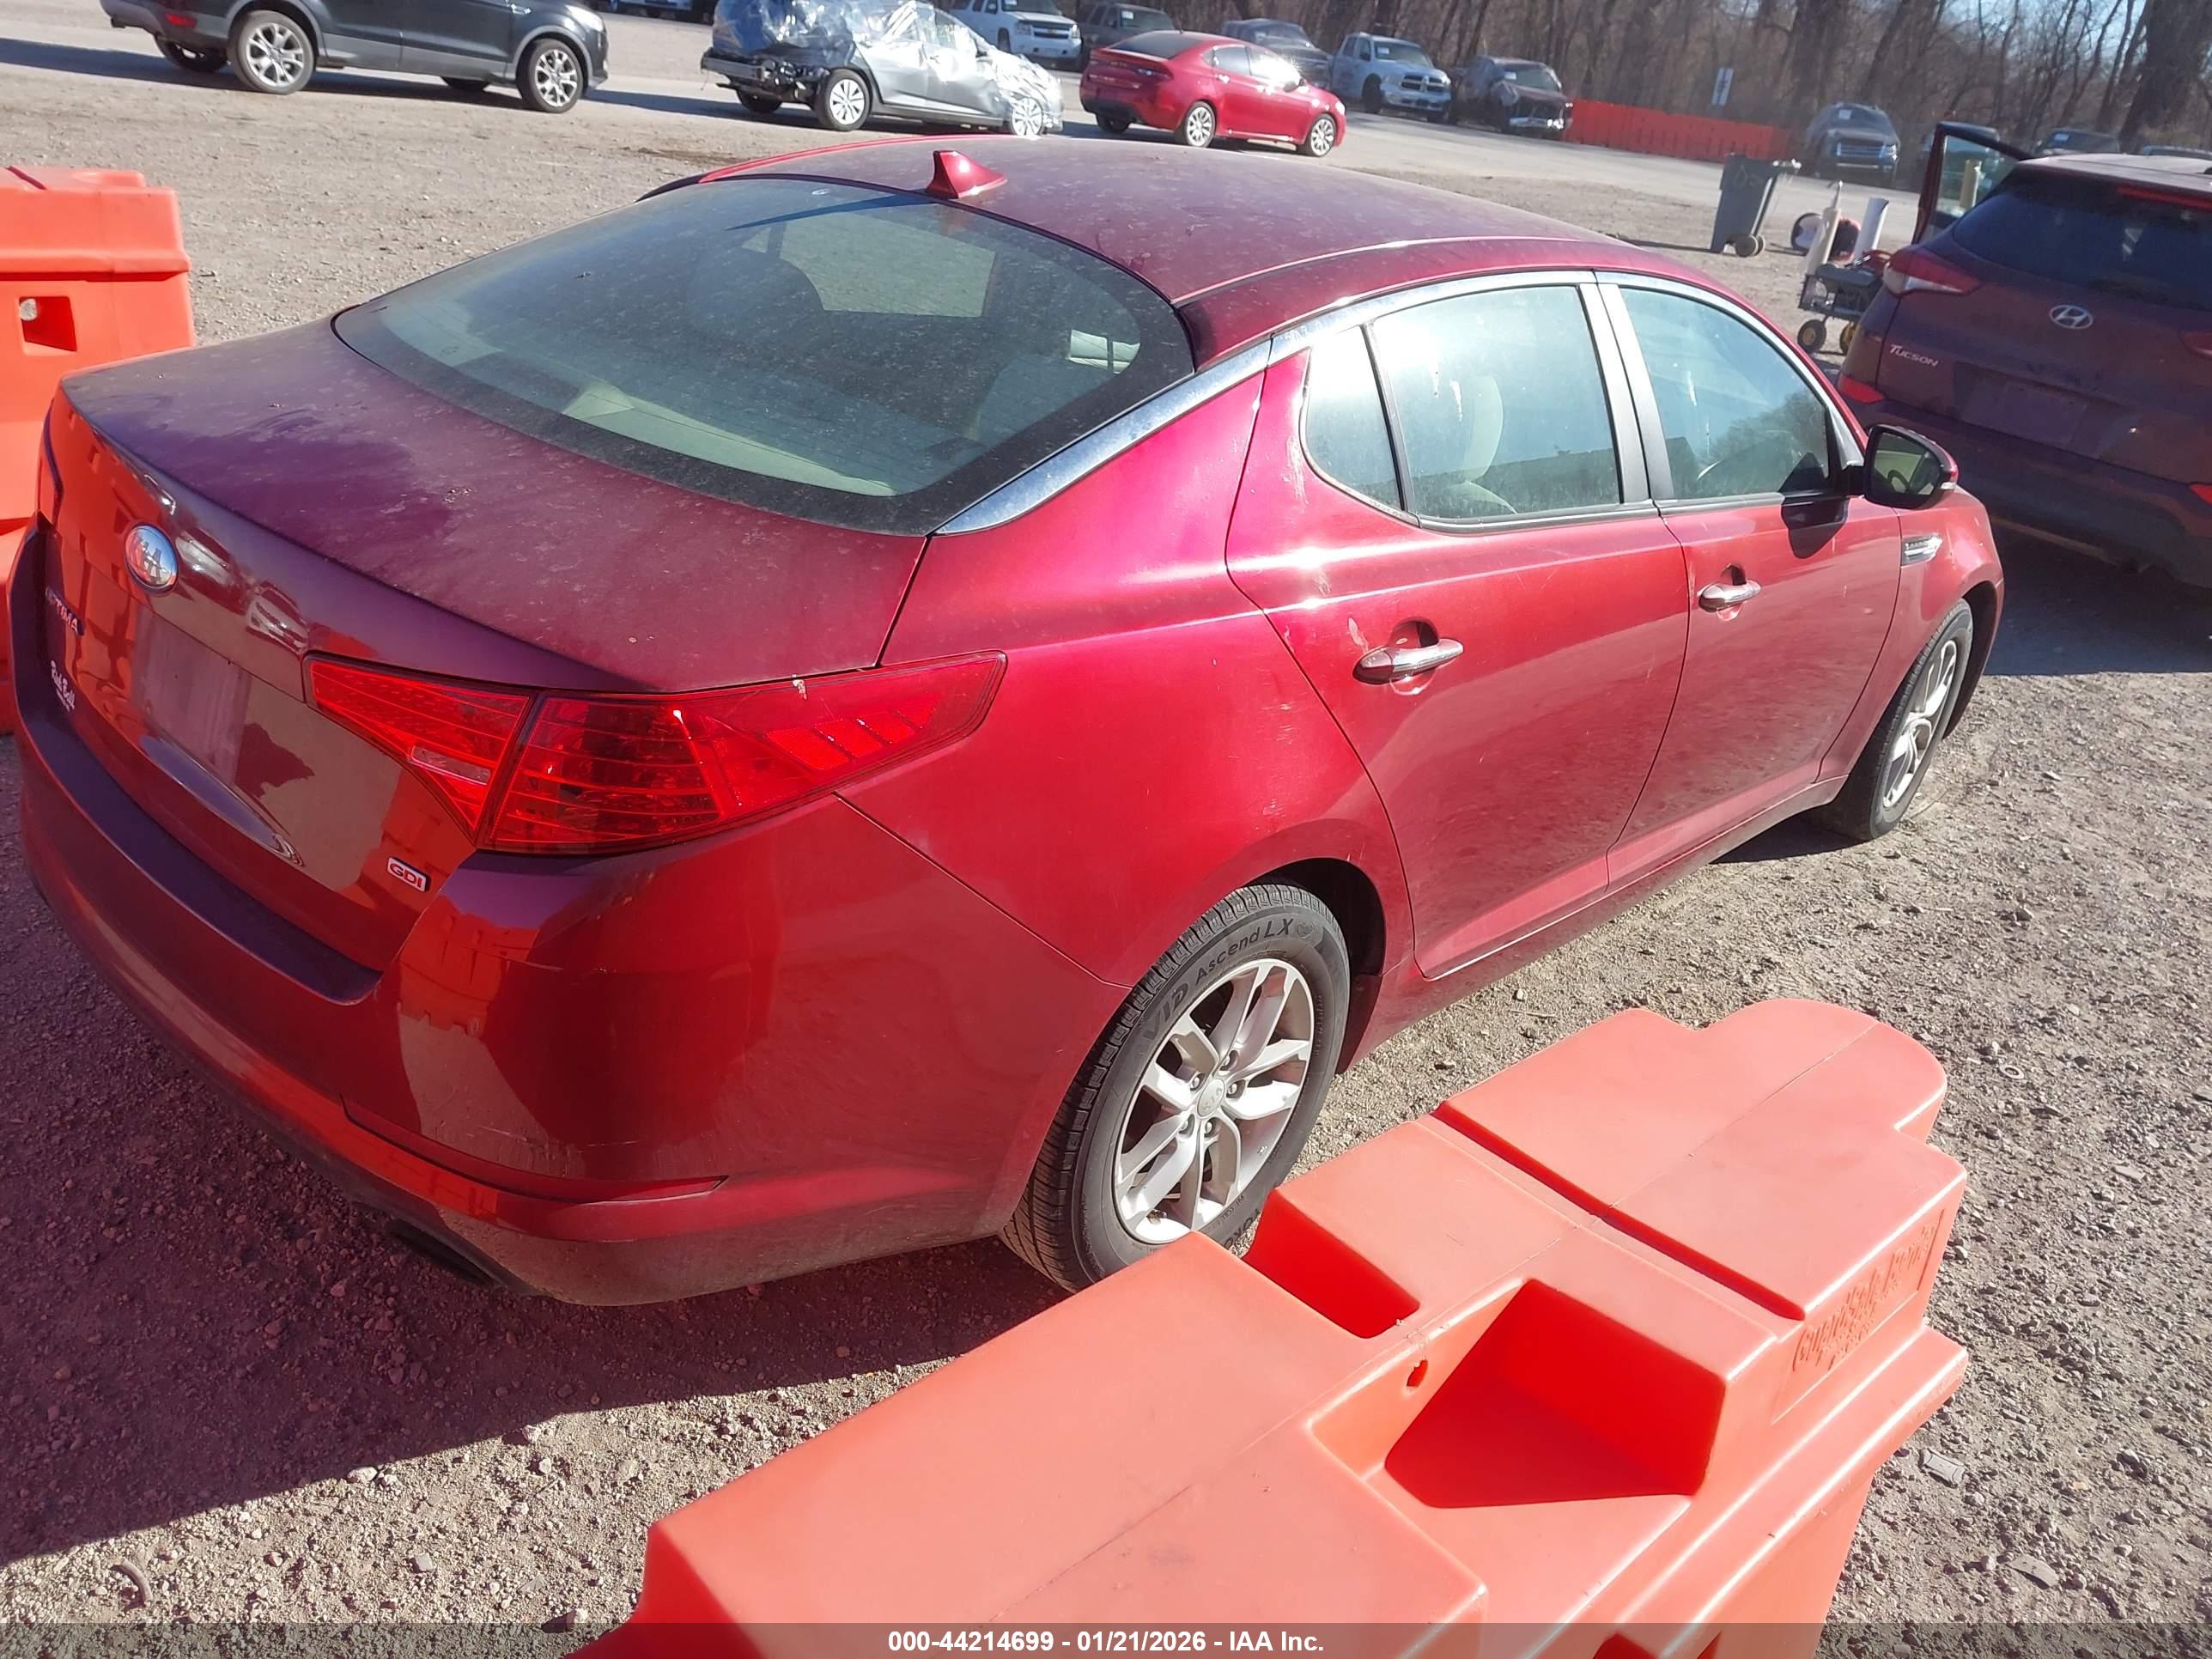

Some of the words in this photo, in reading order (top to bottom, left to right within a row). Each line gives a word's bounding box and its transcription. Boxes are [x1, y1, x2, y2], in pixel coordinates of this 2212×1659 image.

[390, 863, 422, 888] GDI
[1194, 927, 1261, 986] Ascend
[1263, 917, 1294, 938] LX
